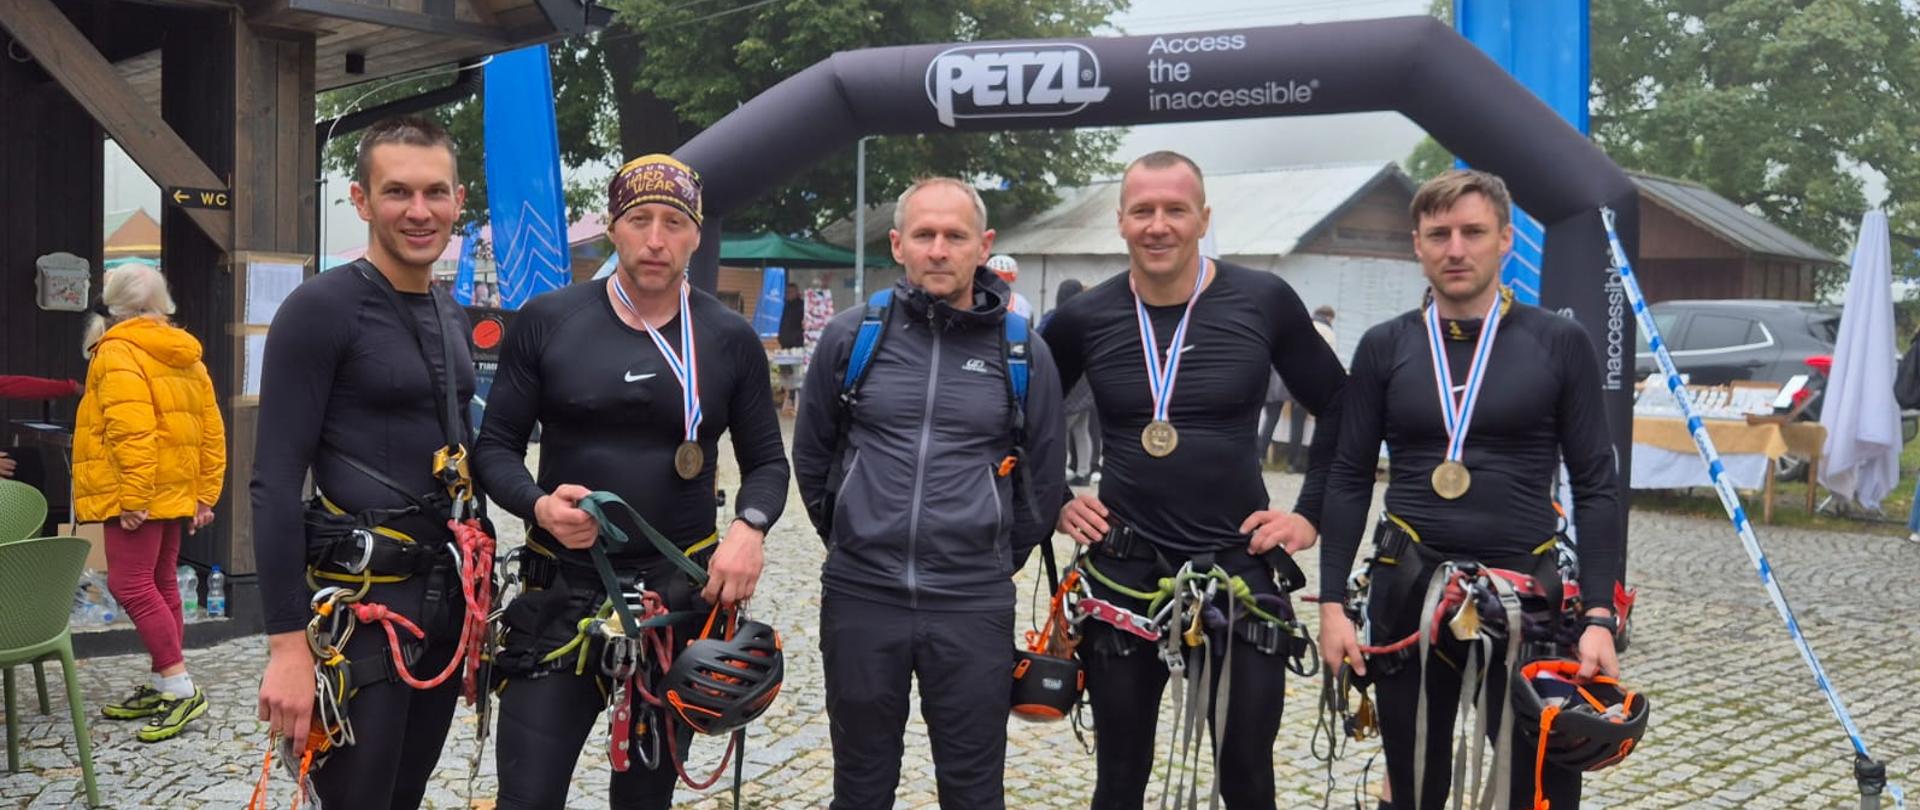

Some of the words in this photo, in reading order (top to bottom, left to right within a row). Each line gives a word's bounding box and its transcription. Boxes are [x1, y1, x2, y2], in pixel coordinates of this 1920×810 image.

[1148, 34, 1246, 55] Access
[1148, 59, 1191, 83] the
[936, 50, 1111, 127] PETZL
[633, 179, 676, 194] WEAR
[200, 192, 228, 206] WC
